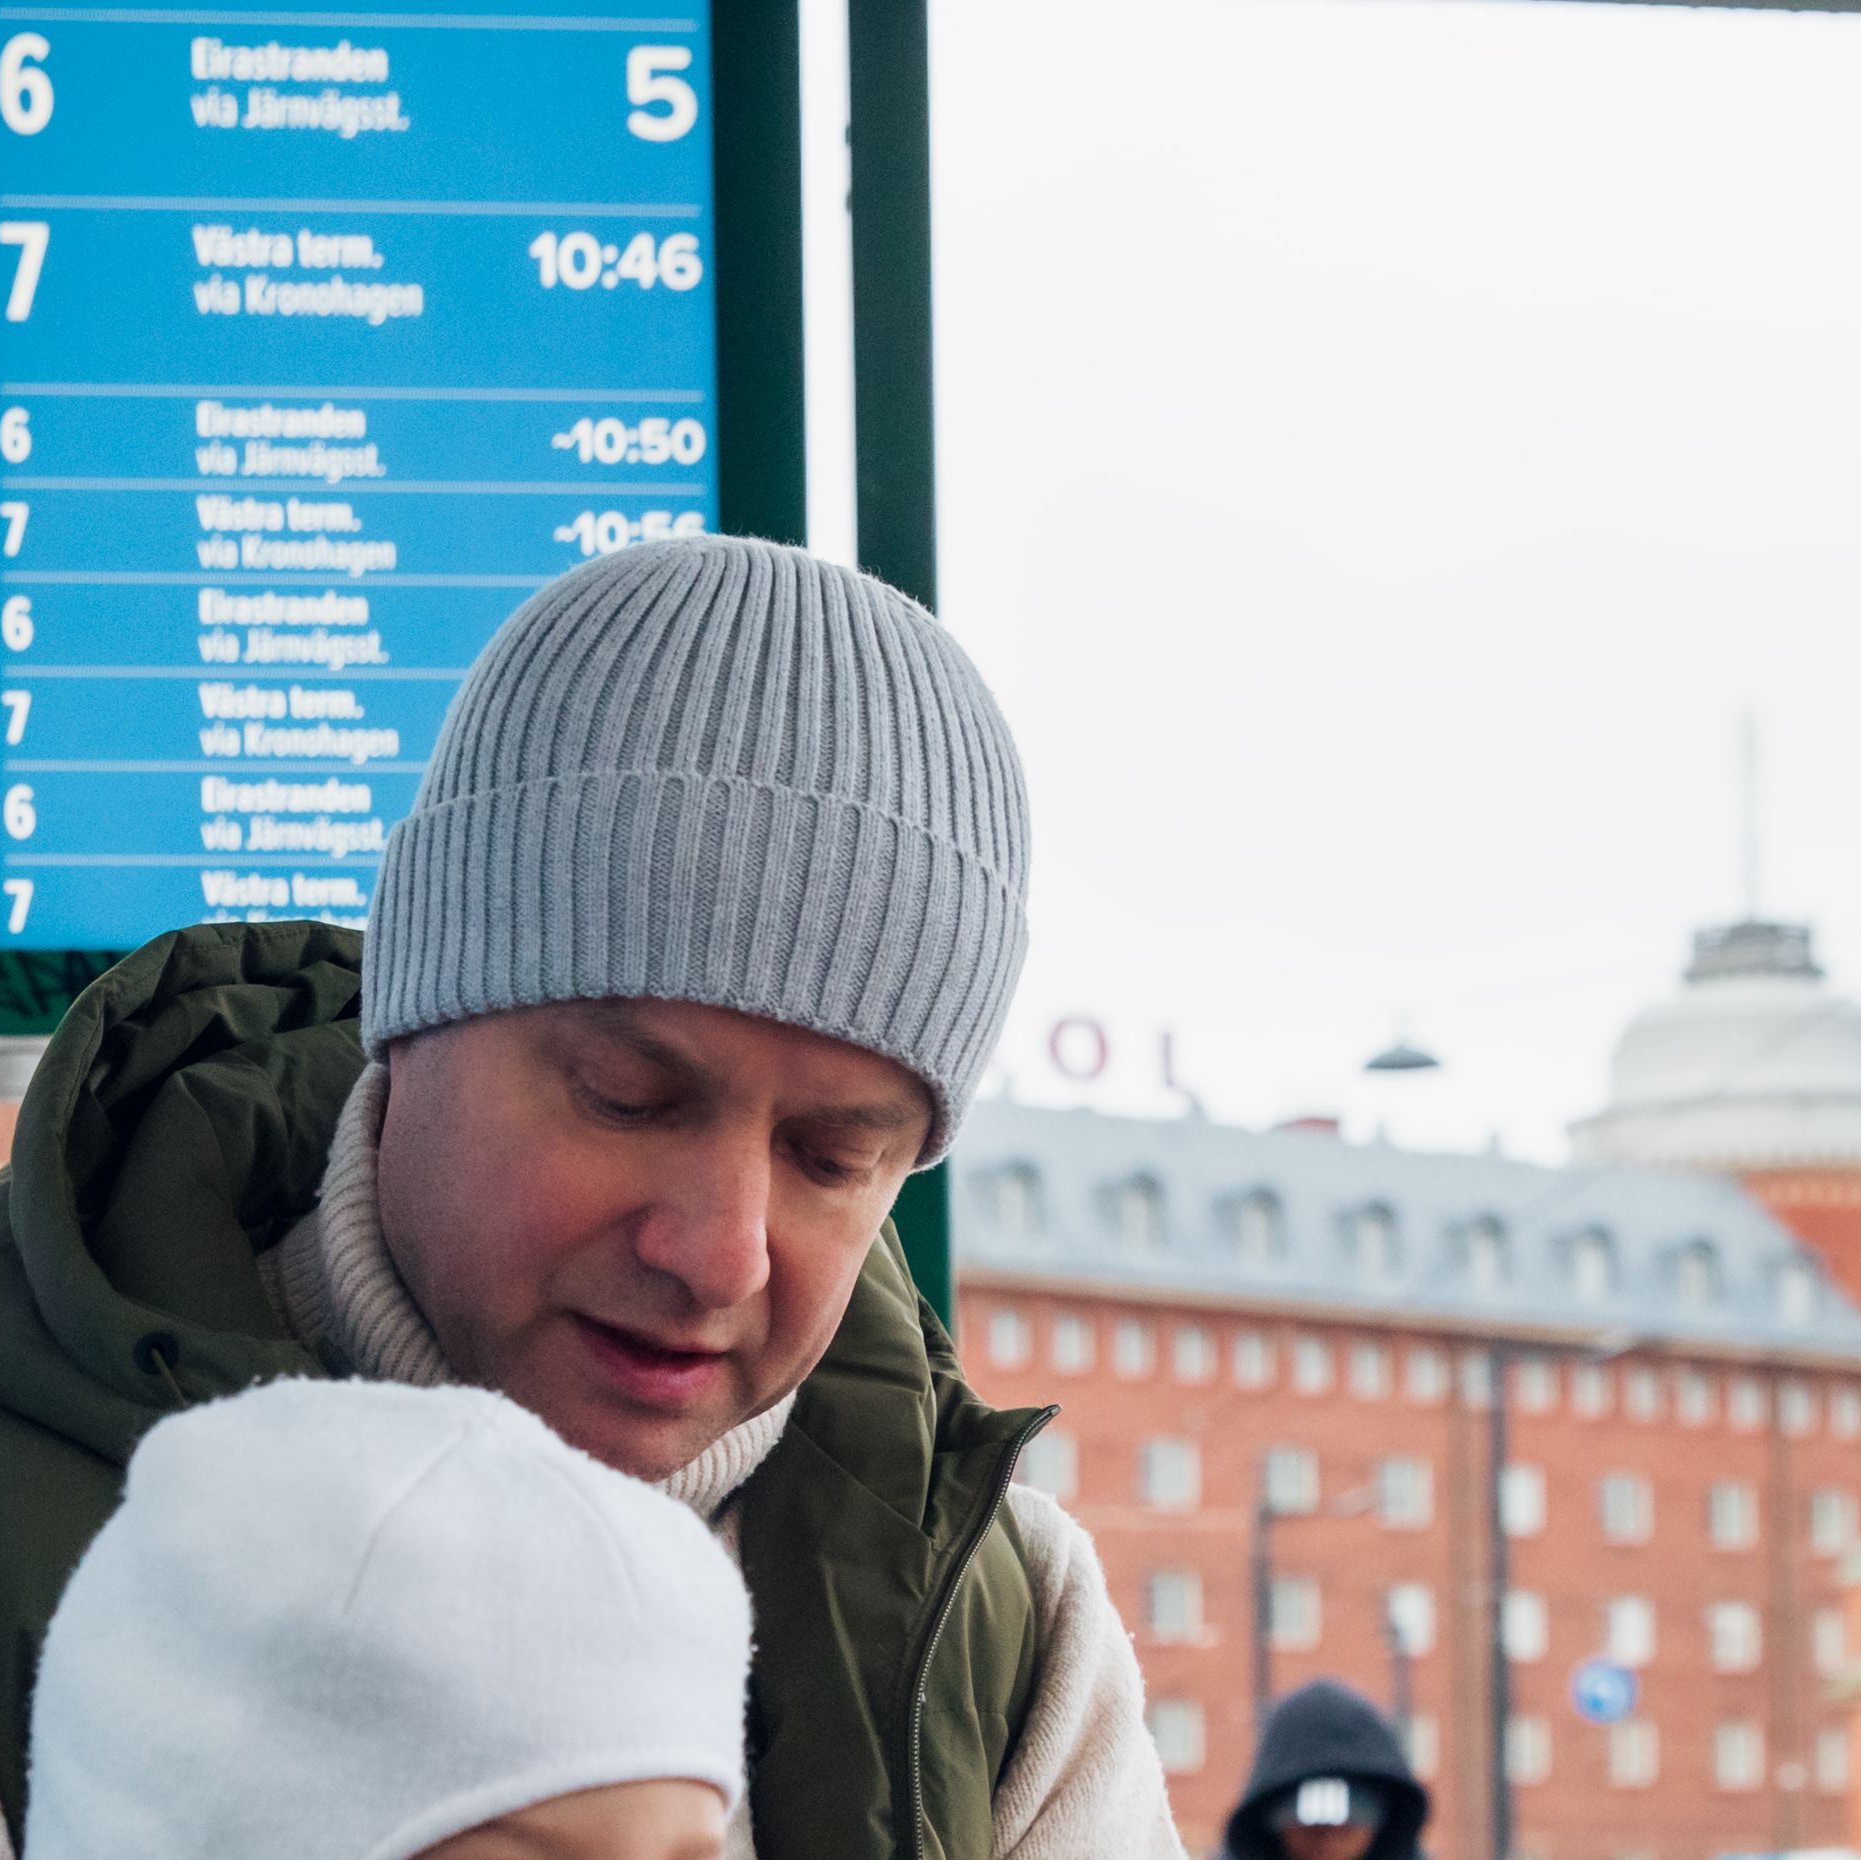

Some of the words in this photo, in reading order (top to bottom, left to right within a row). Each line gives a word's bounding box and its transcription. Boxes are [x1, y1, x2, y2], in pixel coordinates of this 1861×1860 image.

[192, 38, 388, 82] Eirastranden
[192, 88, 238, 127] via
[627, 46, 697, 141] 5
[193, 226, 293, 267] Västra
[297, 230, 383, 268] term.
[530, 232, 702, 290] 10:46
[194, 275, 240, 314] via
[246, 275, 423, 325] Kronohagen
[0, 408, 31, 463] 6
[196, 400, 366, 438] Eirastranden
[196, 440, 237, 475] via
[0, 502, 29, 556] 7
[197, 495, 284, 531] Västra
[198, 534, 238, 568] via
[241, 534, 397, 577] Kronohagen
[2, 596, 33, 651] 6
[199, 588, 369, 625] Eirastranden
[199, 628, 240, 662] via
[2, 690, 31, 744] 7
[199, 683, 287, 719] Västra
[200, 722, 241, 756] via
[244, 722, 399, 765] Kronohagen
[4, 784, 36, 840] 6
[201, 776, 371, 813] Eirastranden
[201, 816, 242, 850] via
[4, 879, 33, 933] 7
[201, 871, 289, 906] Västra
